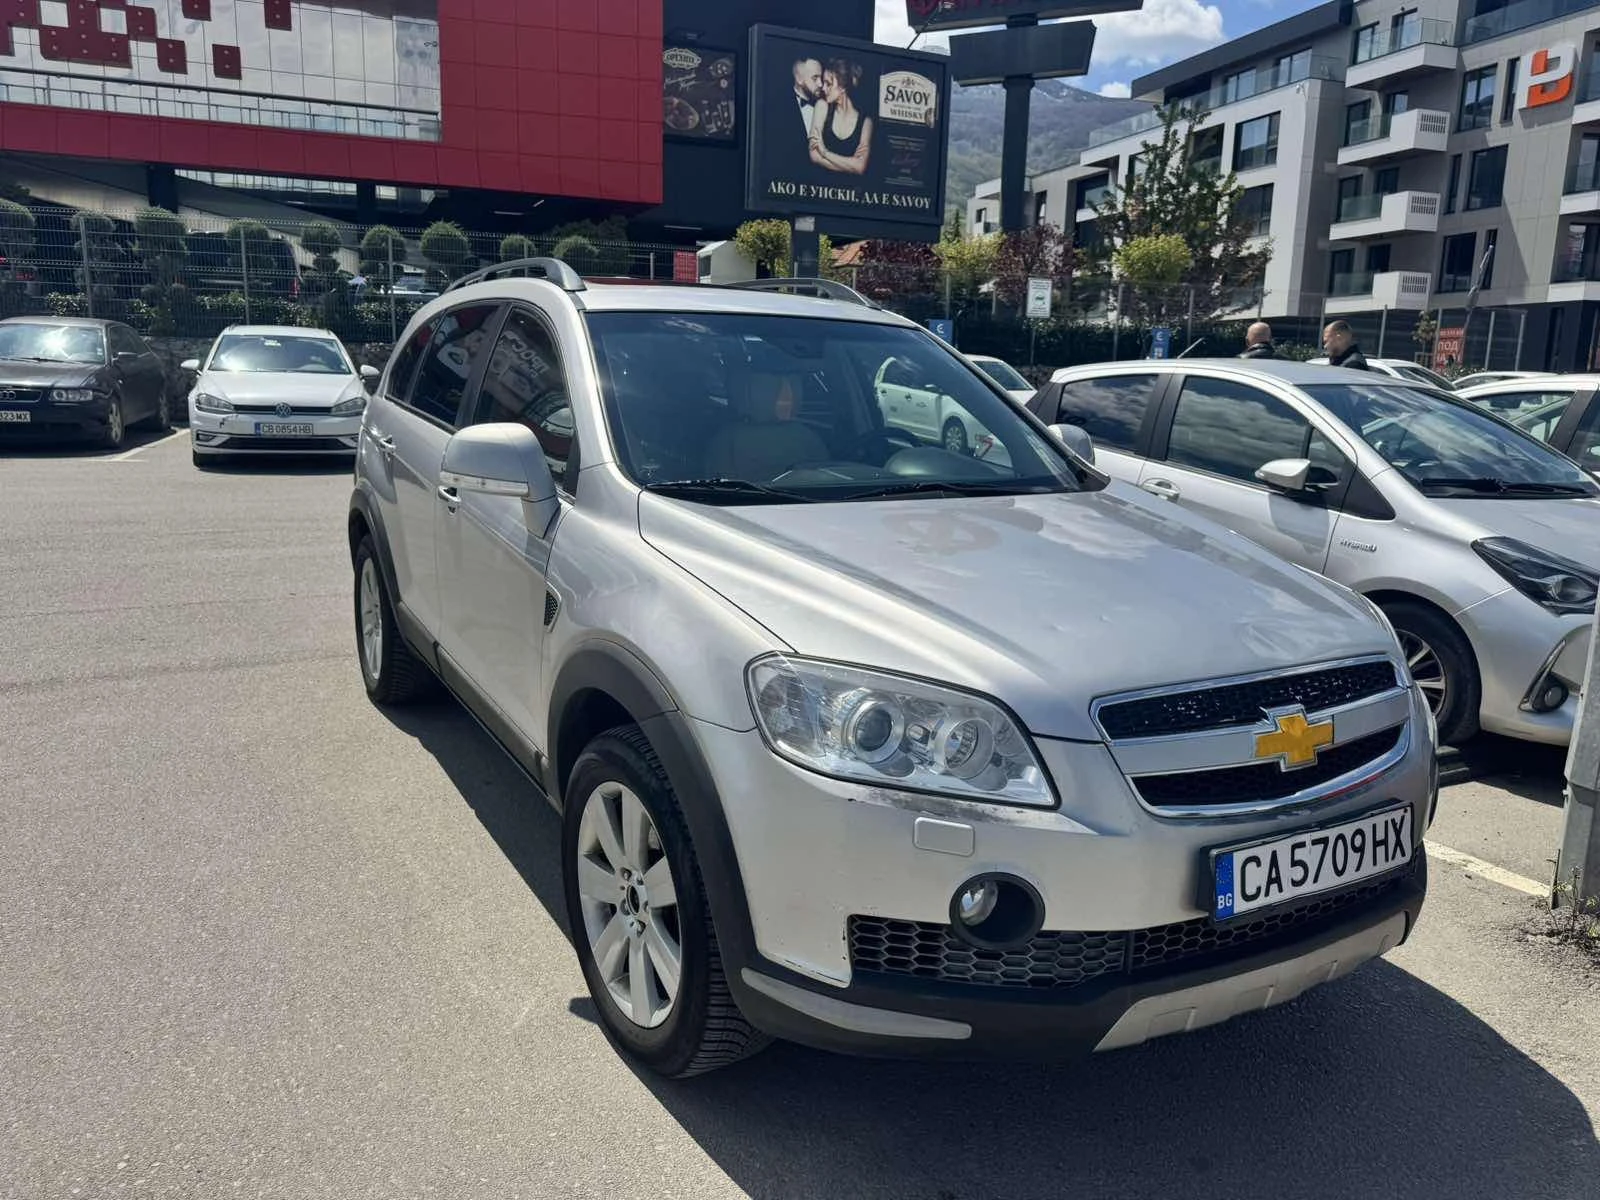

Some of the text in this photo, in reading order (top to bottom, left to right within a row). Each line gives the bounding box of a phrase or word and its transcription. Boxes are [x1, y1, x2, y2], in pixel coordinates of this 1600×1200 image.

[768, 181, 796, 195] АКО
[892, 195, 932, 209] SAVOY
[1217, 893, 1233, 910] BG
